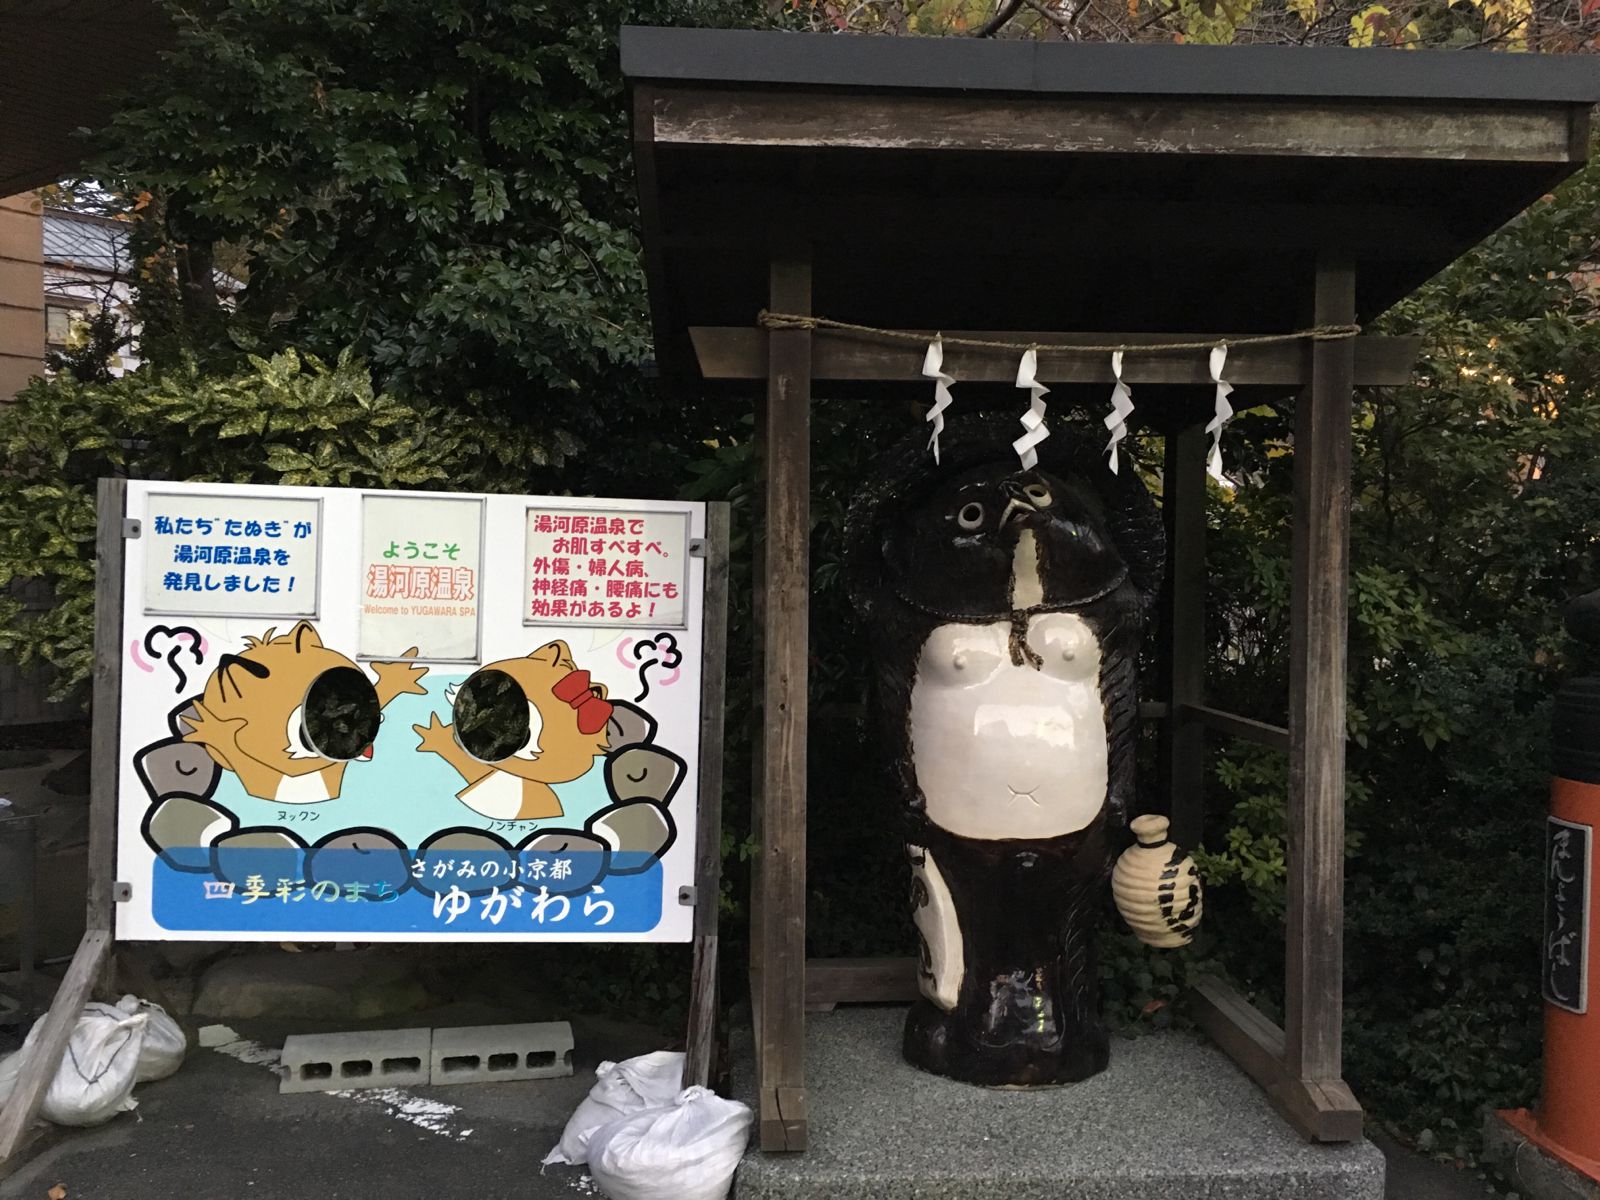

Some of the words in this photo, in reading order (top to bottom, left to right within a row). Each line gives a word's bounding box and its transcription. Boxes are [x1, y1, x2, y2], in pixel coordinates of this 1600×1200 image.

[533, 514, 645, 535] 湯河原温泉で
[173, 544, 290, 566] 湯河原温泉を
[383, 540, 461, 561] ようこそ
[552, 537, 669, 558] お肌すべすべ。
[532, 557, 649, 578] 外傷・婦人病、
[163, 571, 296, 593] 発見しました！
[366, 563, 475, 601] 湯河原温泉
[532, 577, 679, 599] 神経痛・腰痛にも
[364, 604, 399, 615] Welcome
[401, 605, 409, 615] to
[411, 605, 457, 616] YUGAWARA
[459, 606, 476, 617] SPA
[531, 598, 656, 619] 効果があるよ！
[277, 810, 320, 821] ヌックン
[485, 821, 539, 832] ノンチャン
[411, 858, 573, 881] さがみの小京都
[203, 874, 399, 905] 四季彩のまち
[432, 884, 615, 926] ゆがわら
